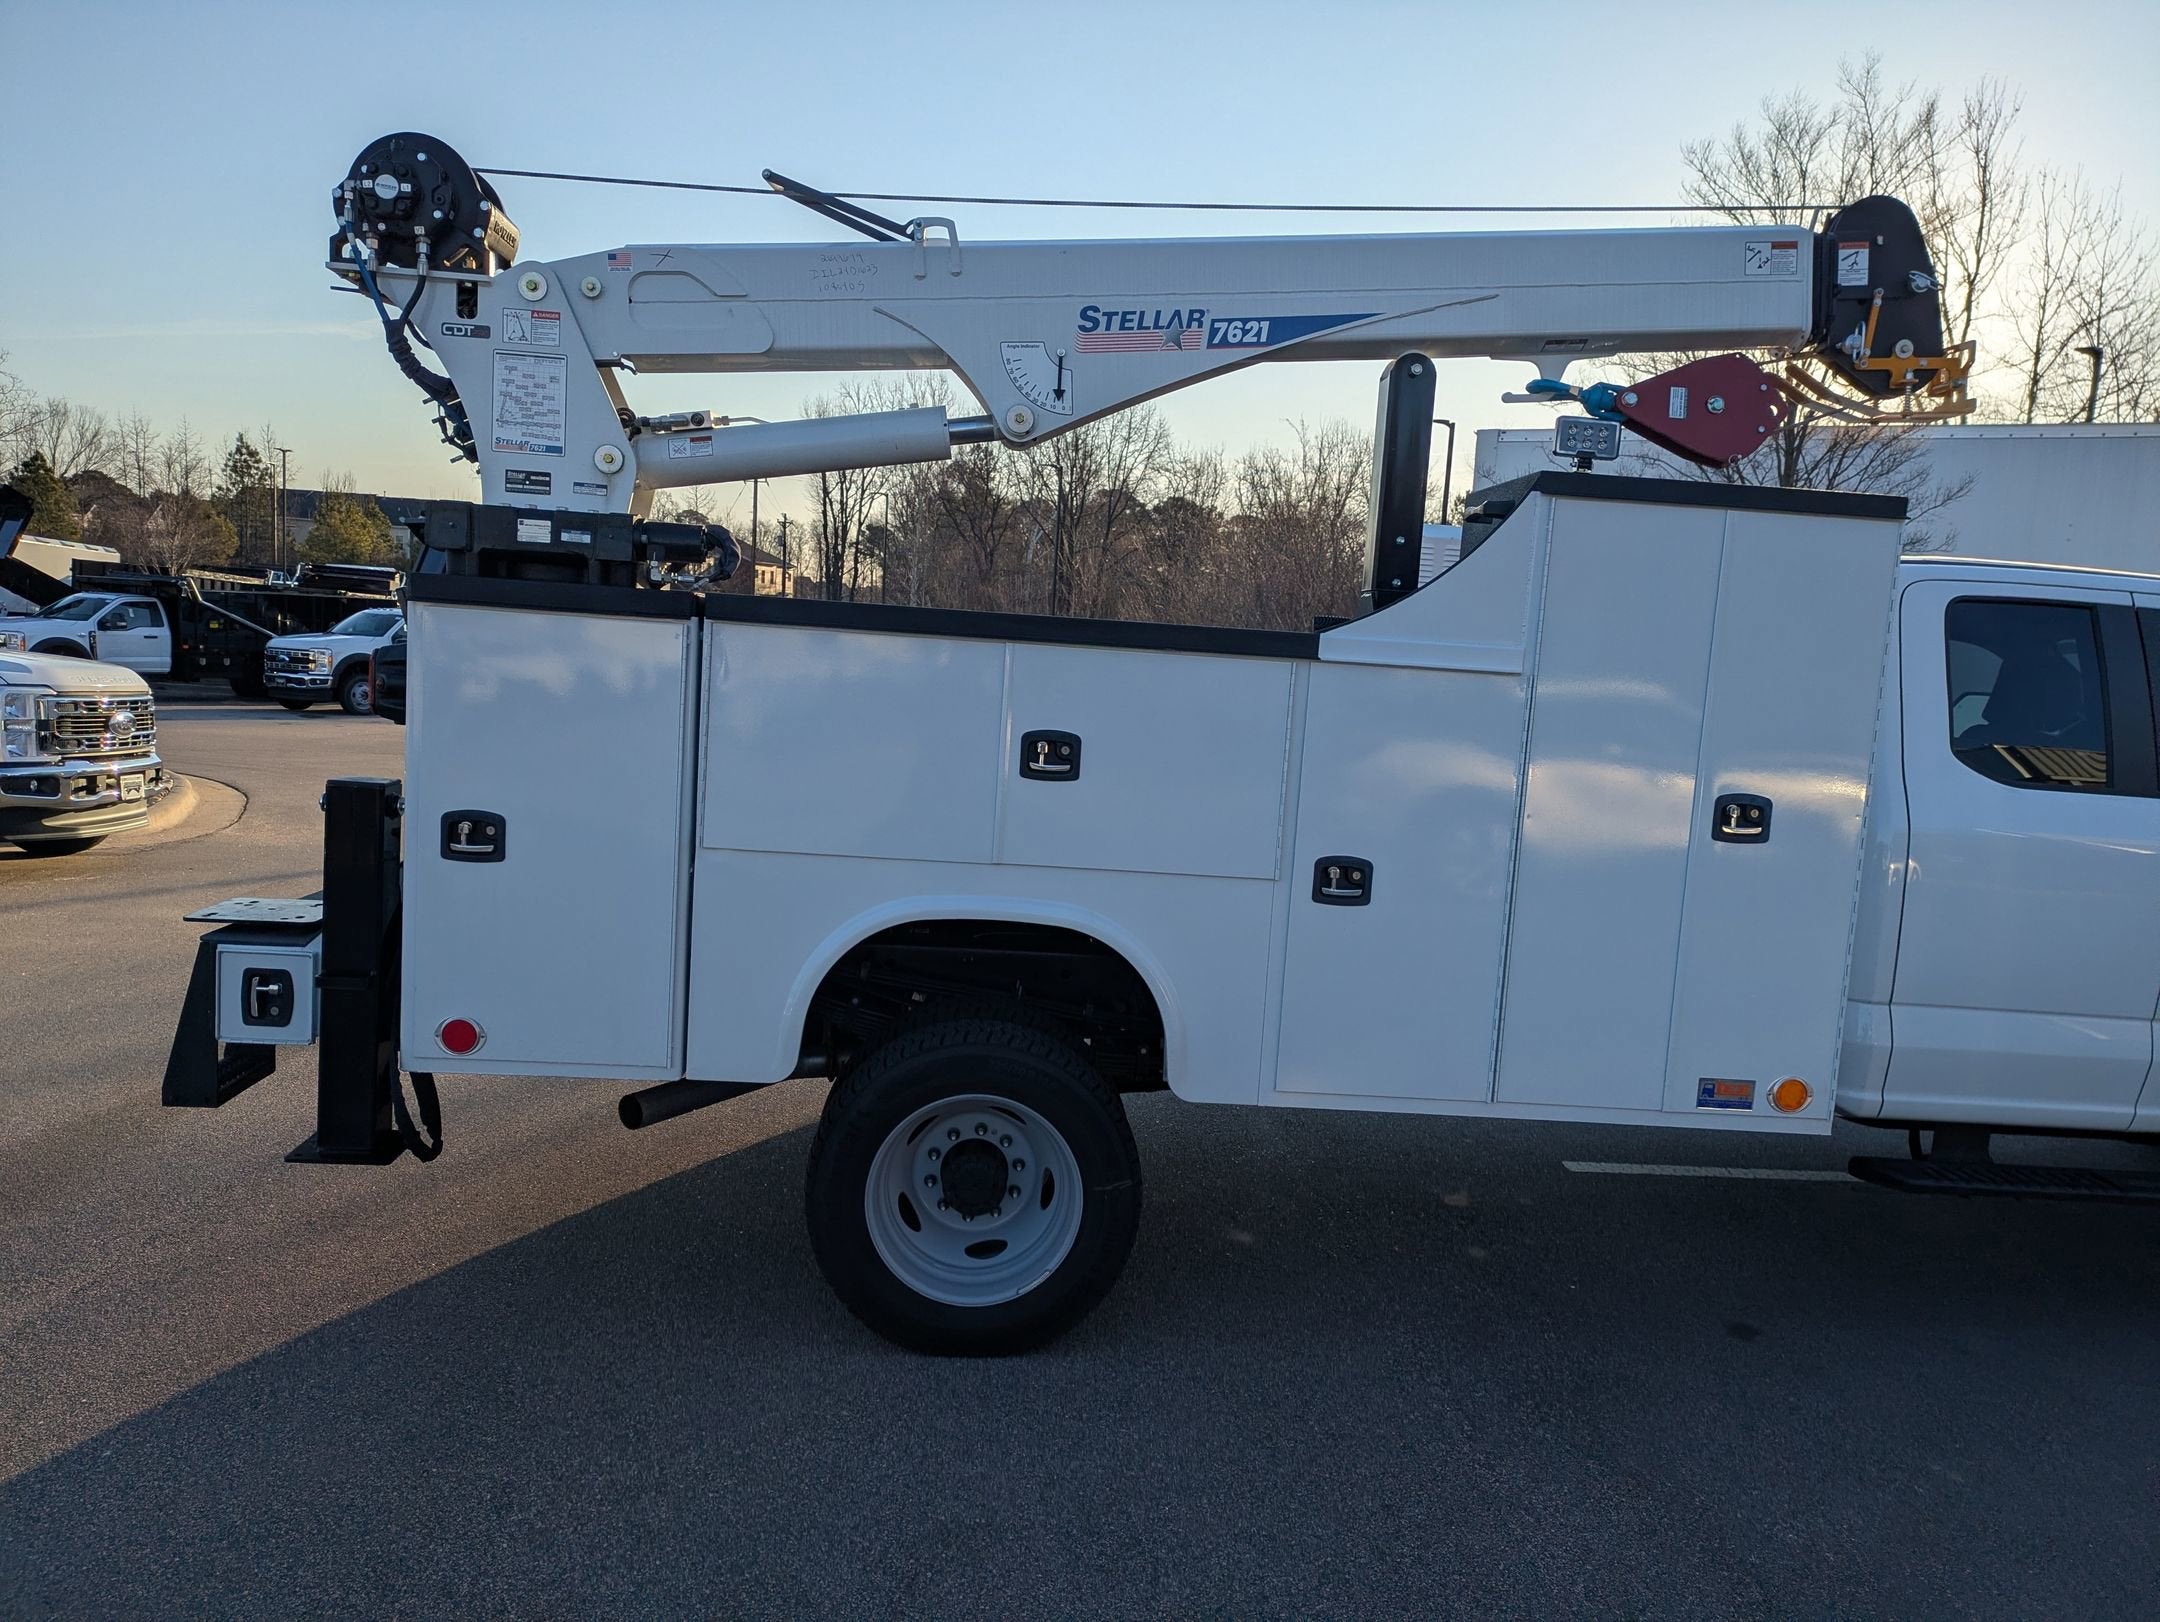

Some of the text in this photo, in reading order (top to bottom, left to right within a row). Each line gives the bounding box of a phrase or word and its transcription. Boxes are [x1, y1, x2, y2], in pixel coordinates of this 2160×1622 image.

[442, 323, 475, 337] CDT
[1077, 304, 1270, 344] STELLAR 7621
[495, 436, 531, 446] STELLAR
[530, 444, 547, 452] 7621
